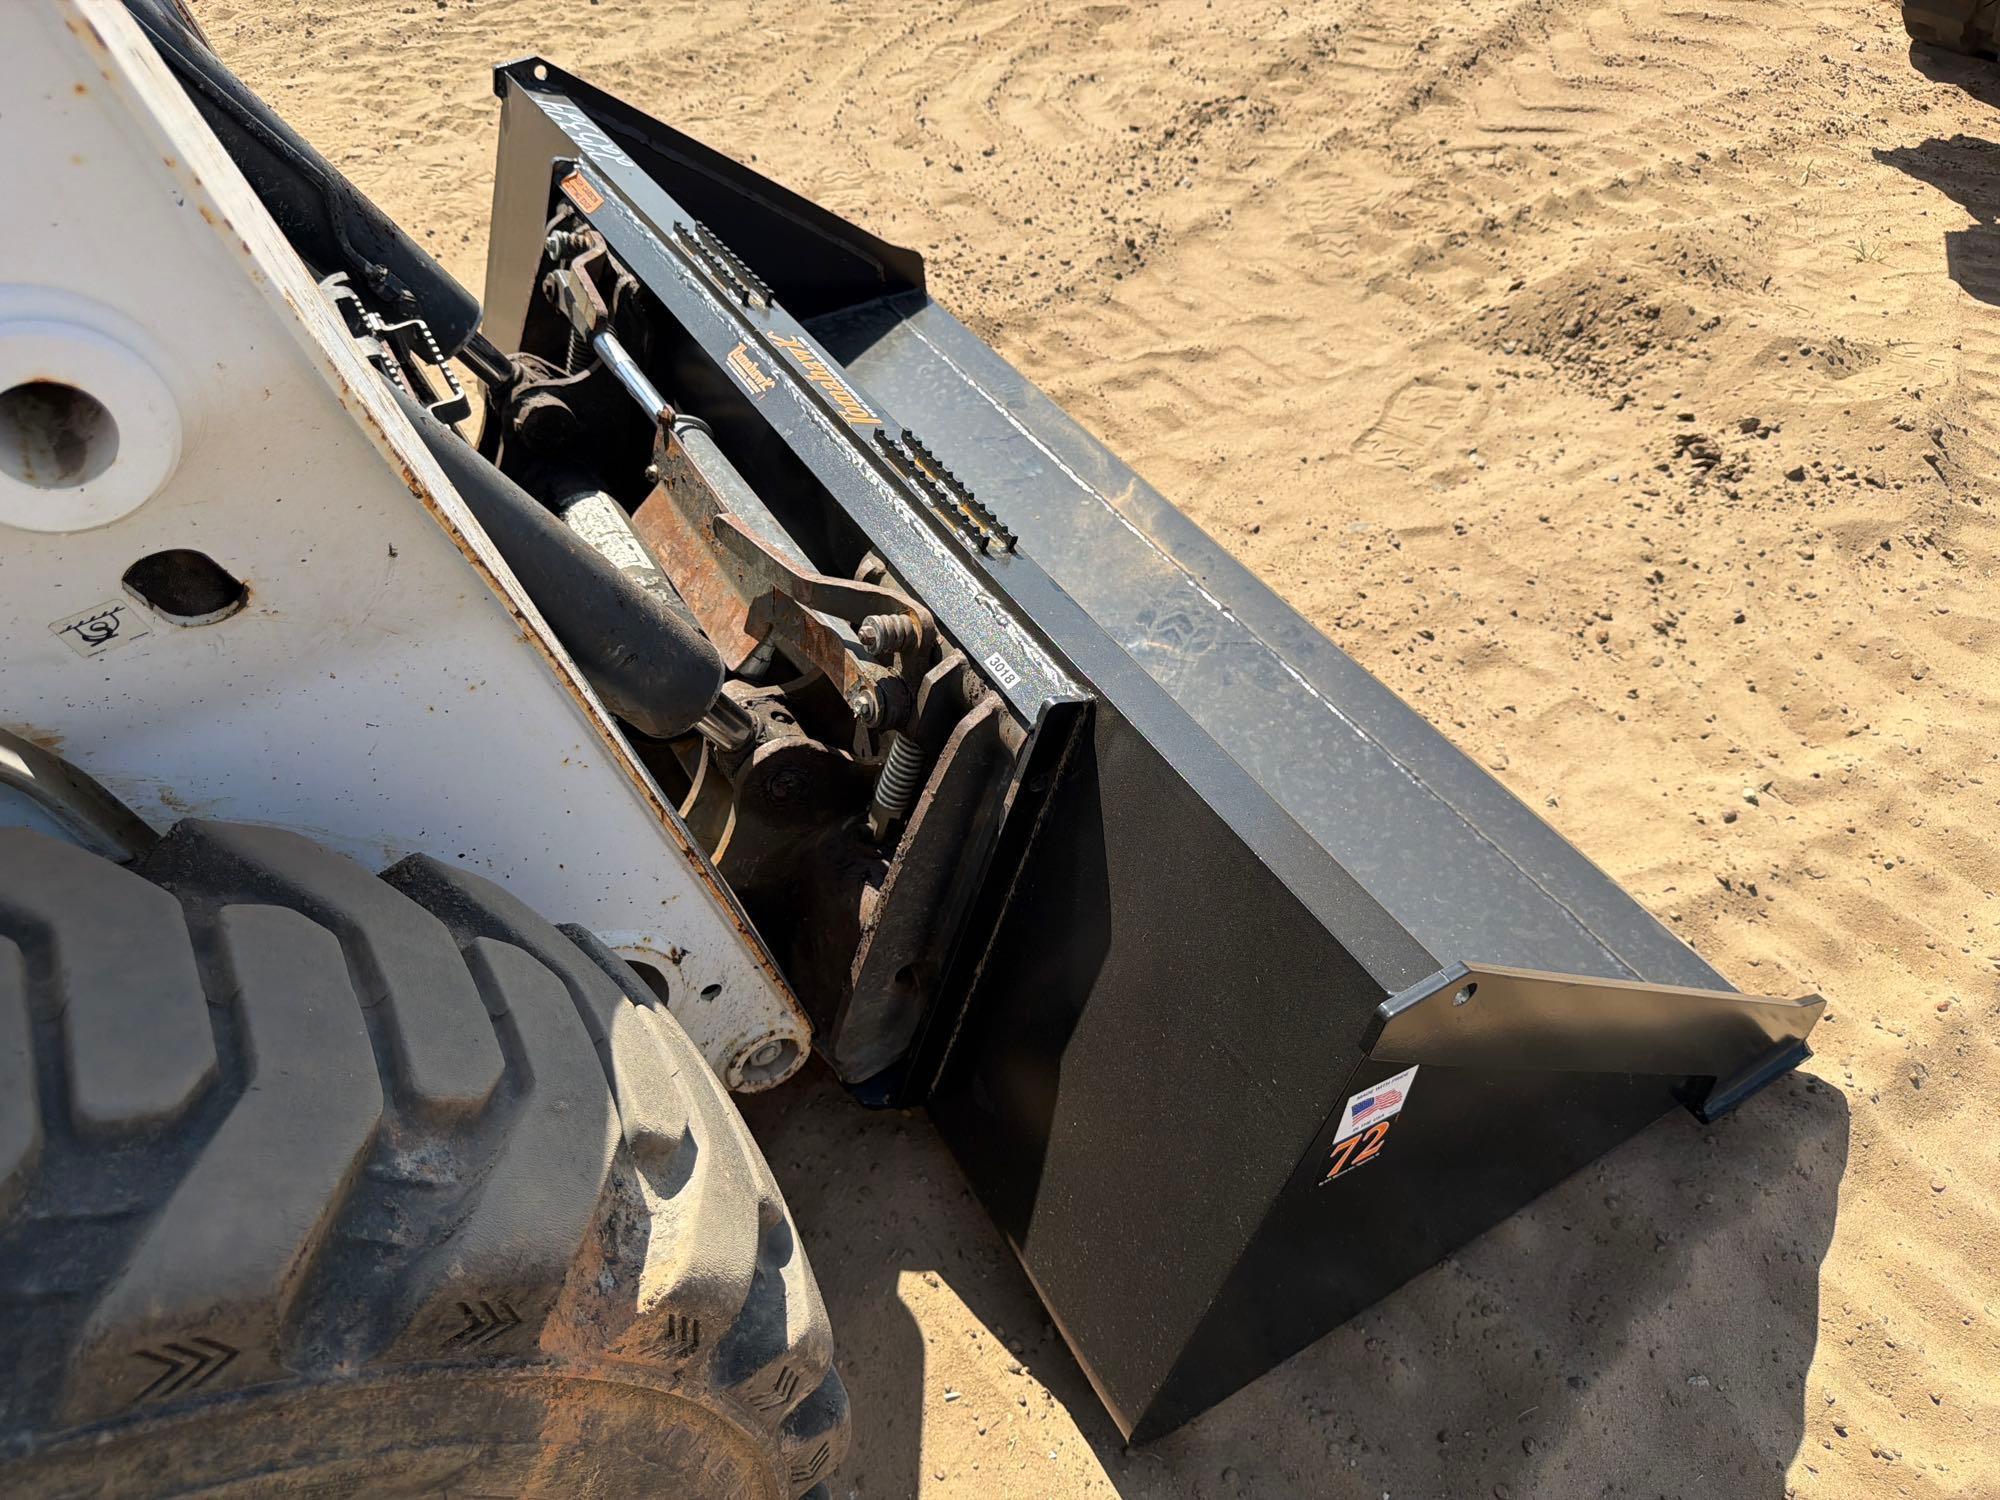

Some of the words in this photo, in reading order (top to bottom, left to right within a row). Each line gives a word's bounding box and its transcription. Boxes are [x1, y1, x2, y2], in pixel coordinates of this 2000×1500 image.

[766, 330, 884, 427] Tomahawk
[989, 657, 1016, 684] 3018
[1326, 1121, 1391, 1178] 72
